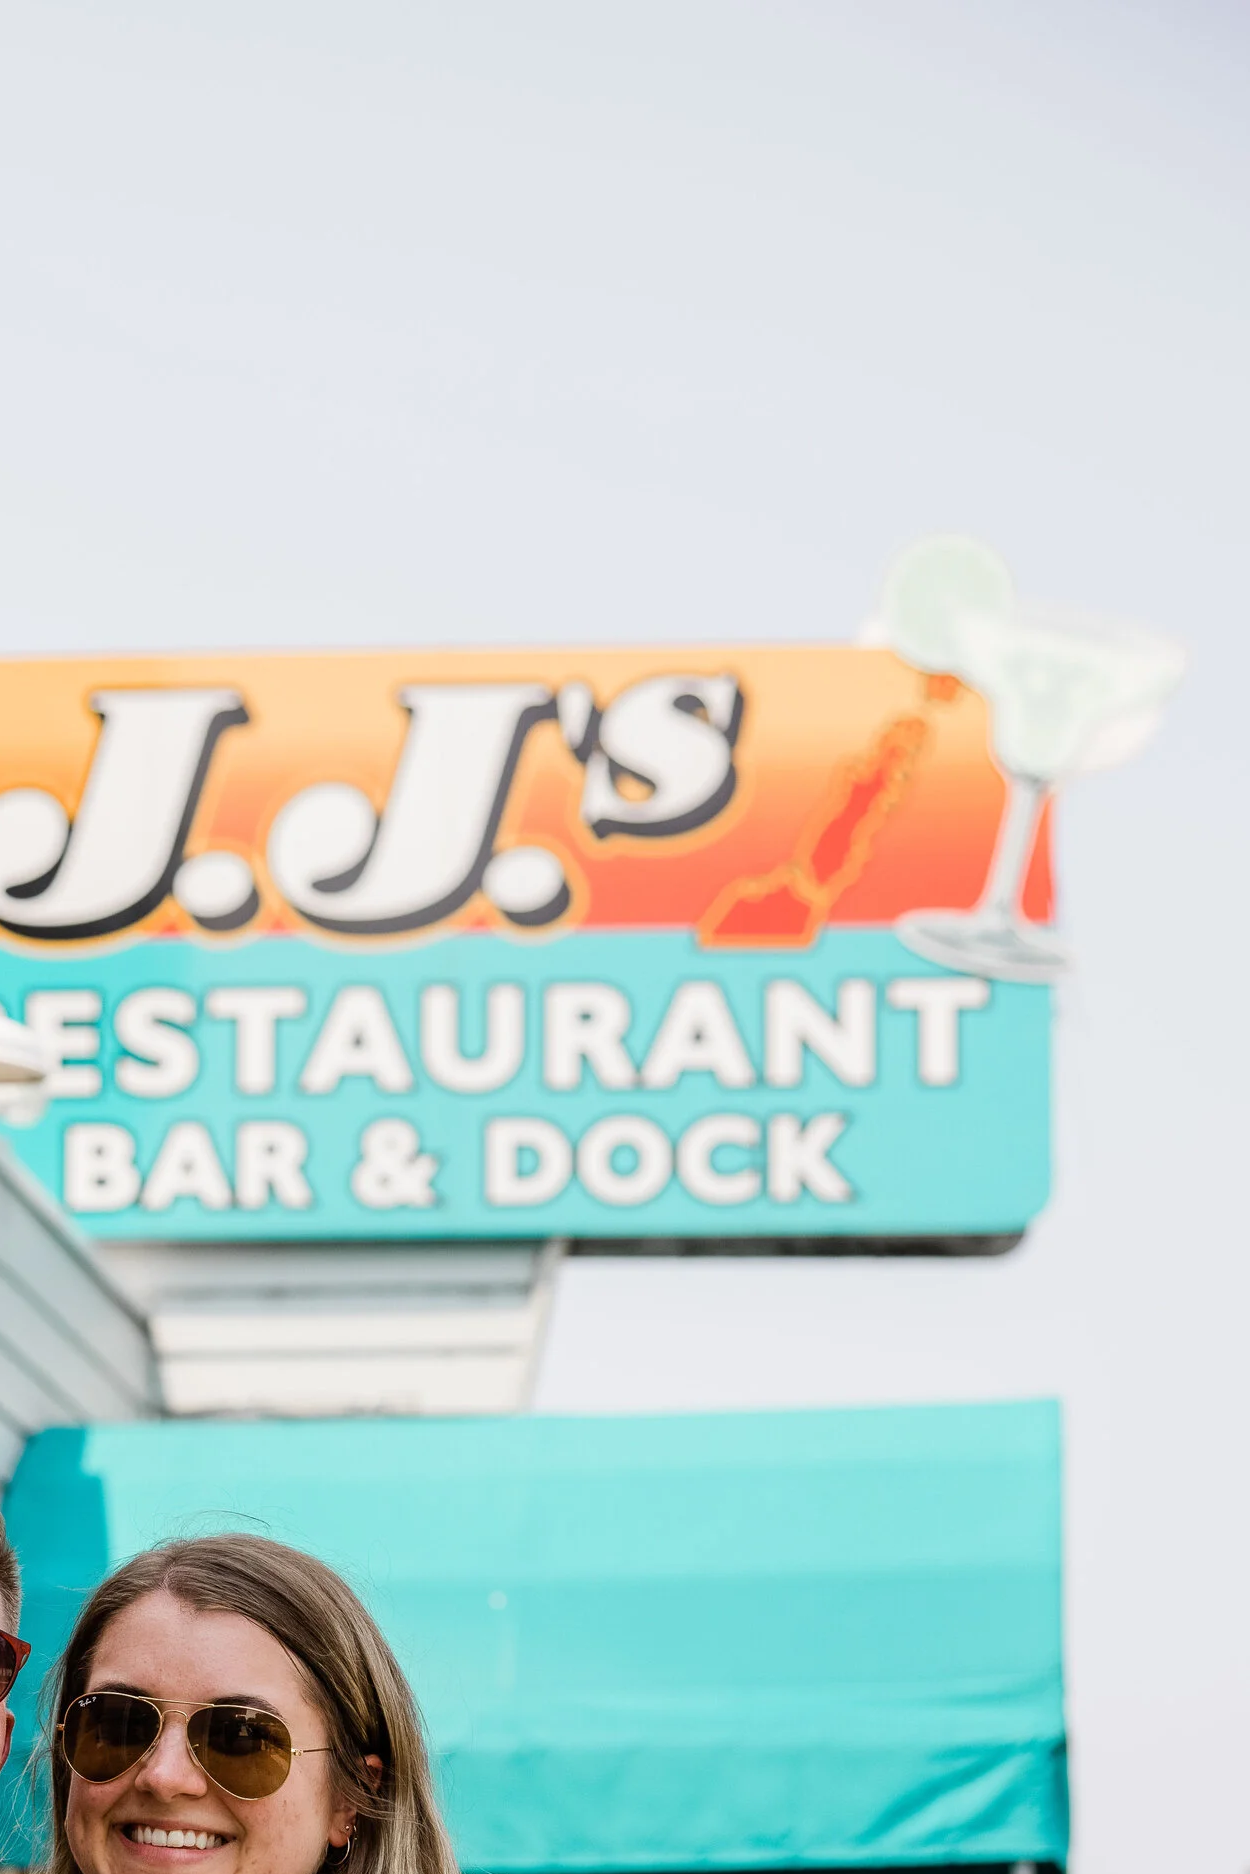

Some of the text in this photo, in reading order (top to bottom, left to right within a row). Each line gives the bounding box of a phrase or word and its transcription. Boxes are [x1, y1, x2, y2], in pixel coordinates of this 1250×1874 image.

[63, 1112, 855, 1213] BAR & DOCK
